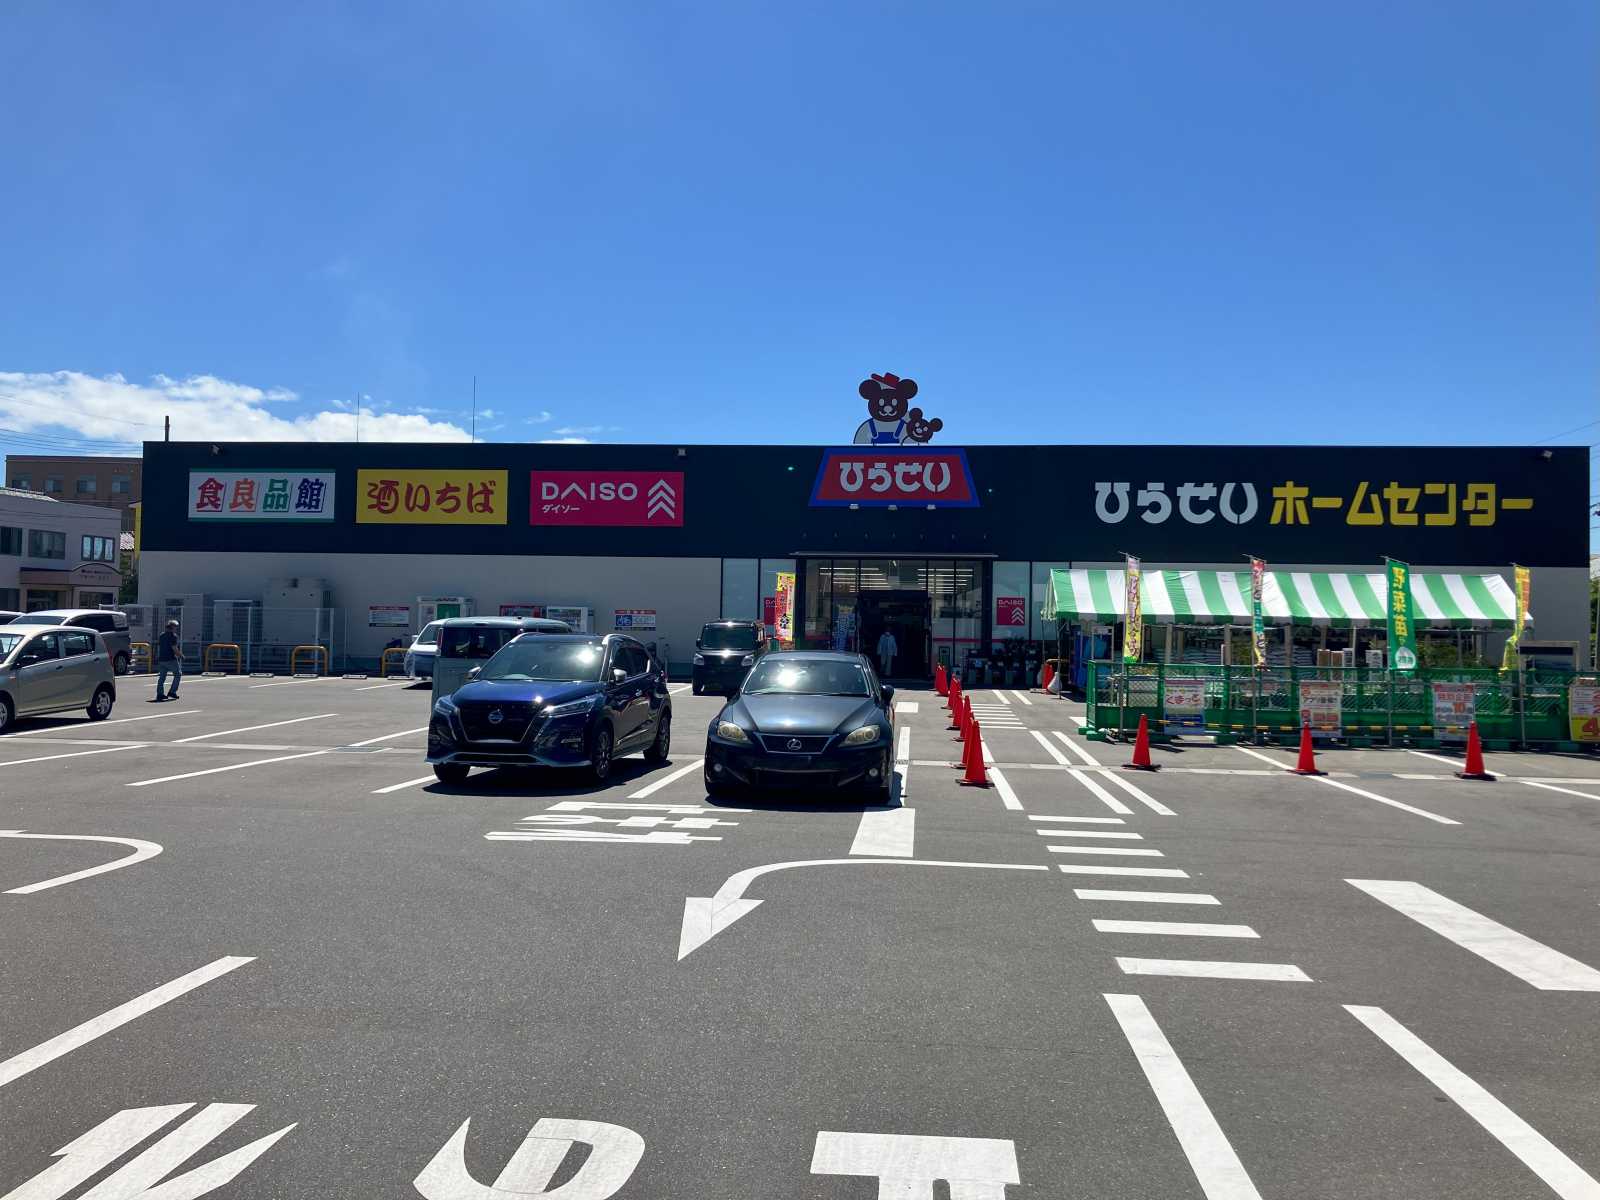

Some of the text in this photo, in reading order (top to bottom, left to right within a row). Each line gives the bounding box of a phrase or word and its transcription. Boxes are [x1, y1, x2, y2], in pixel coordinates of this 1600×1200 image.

[541, 482, 638, 501] DAISO
[839, 462, 951, 493] ひらせい
[196, 477, 326, 513] 食良品館
[367, 479, 496, 514] 酒いちば
[542, 504, 581, 513] ダイソー
[1094, 480, 1534, 526] ひらせい ホームセンター
